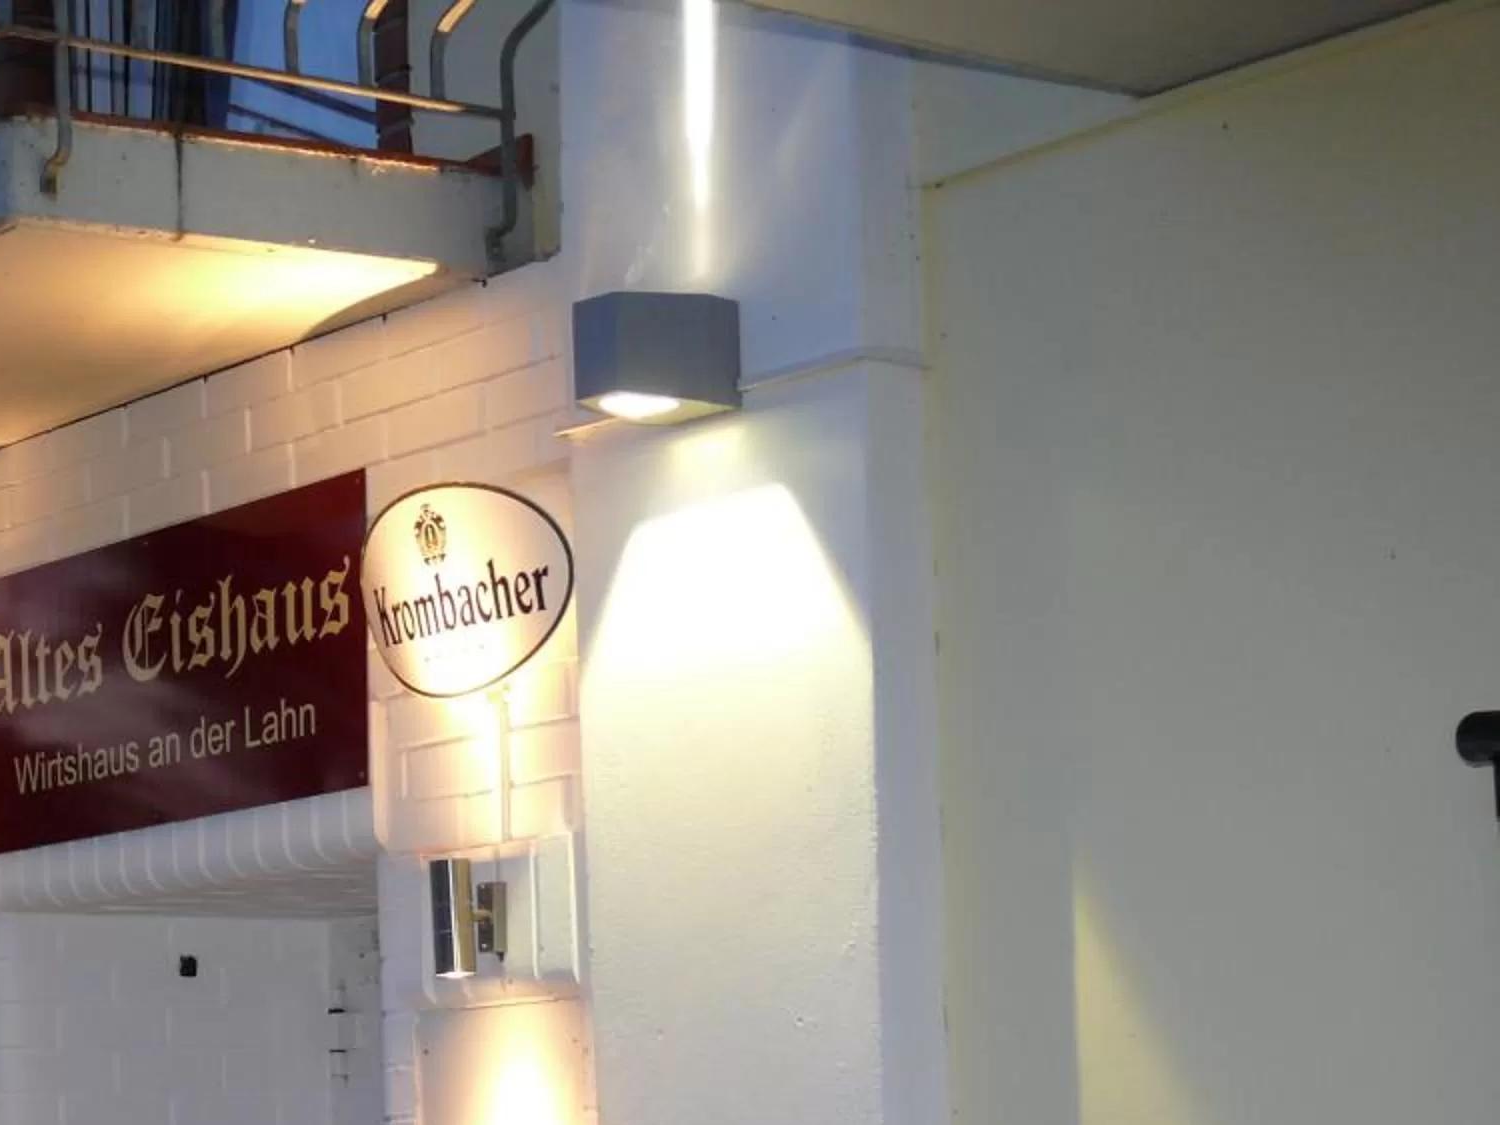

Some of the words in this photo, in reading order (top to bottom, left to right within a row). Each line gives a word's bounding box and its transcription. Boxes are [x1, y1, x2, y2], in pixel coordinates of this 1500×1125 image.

[122, 555, 350, 682] Eishaus
[373, 557, 549, 648] Krombacher
[13, 740, 140, 795] Wirtshaus
[148, 731, 181, 769] an
[190, 716, 235, 759] der
[243, 698, 317, 749] Lahn
